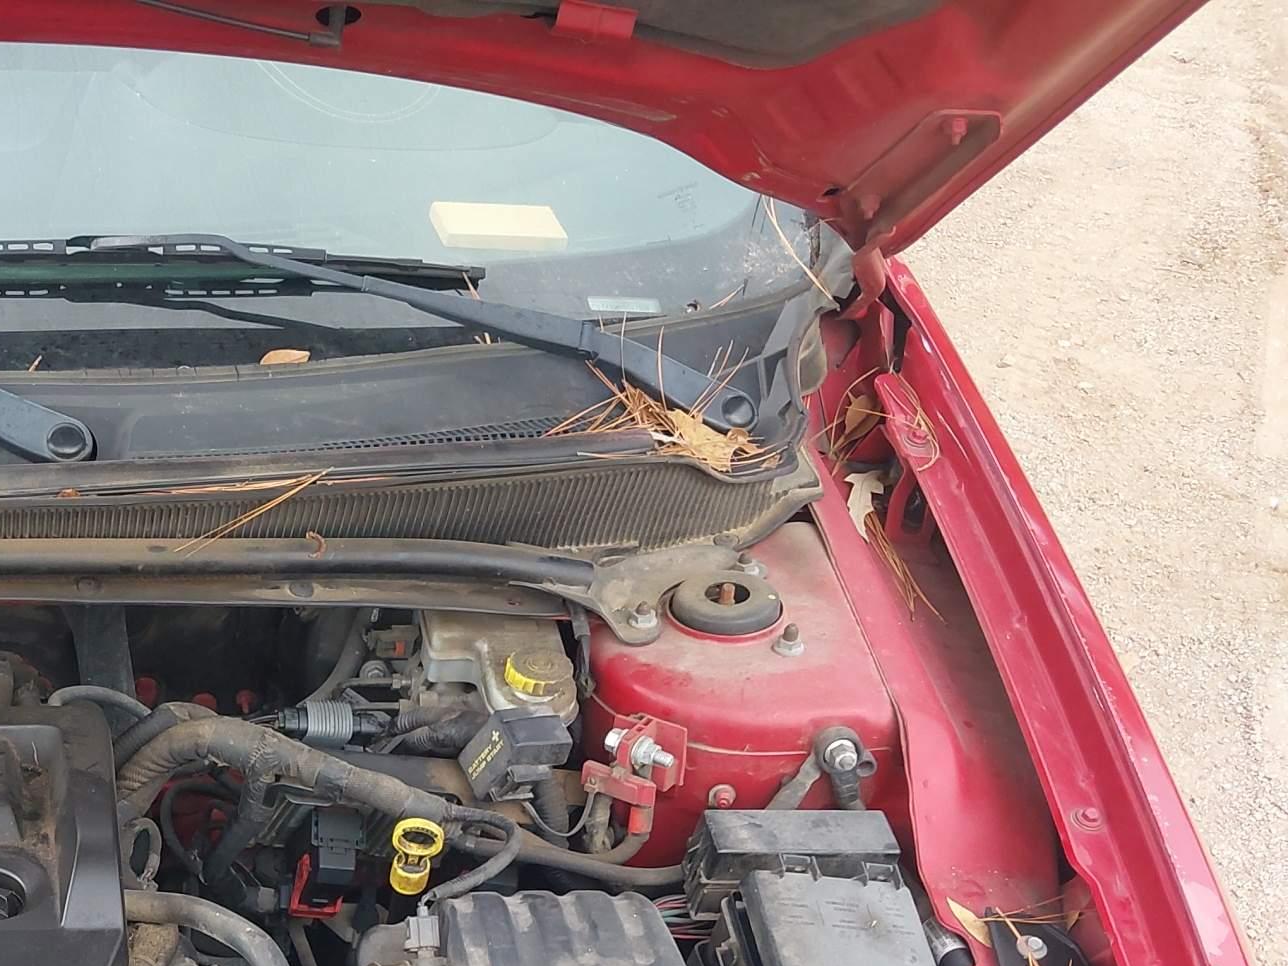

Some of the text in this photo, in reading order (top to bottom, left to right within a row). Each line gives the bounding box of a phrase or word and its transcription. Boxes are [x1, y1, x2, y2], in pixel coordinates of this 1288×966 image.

[468, 743, 492, 774] BATTERY
[471, 739, 504, 780] JUMP START
